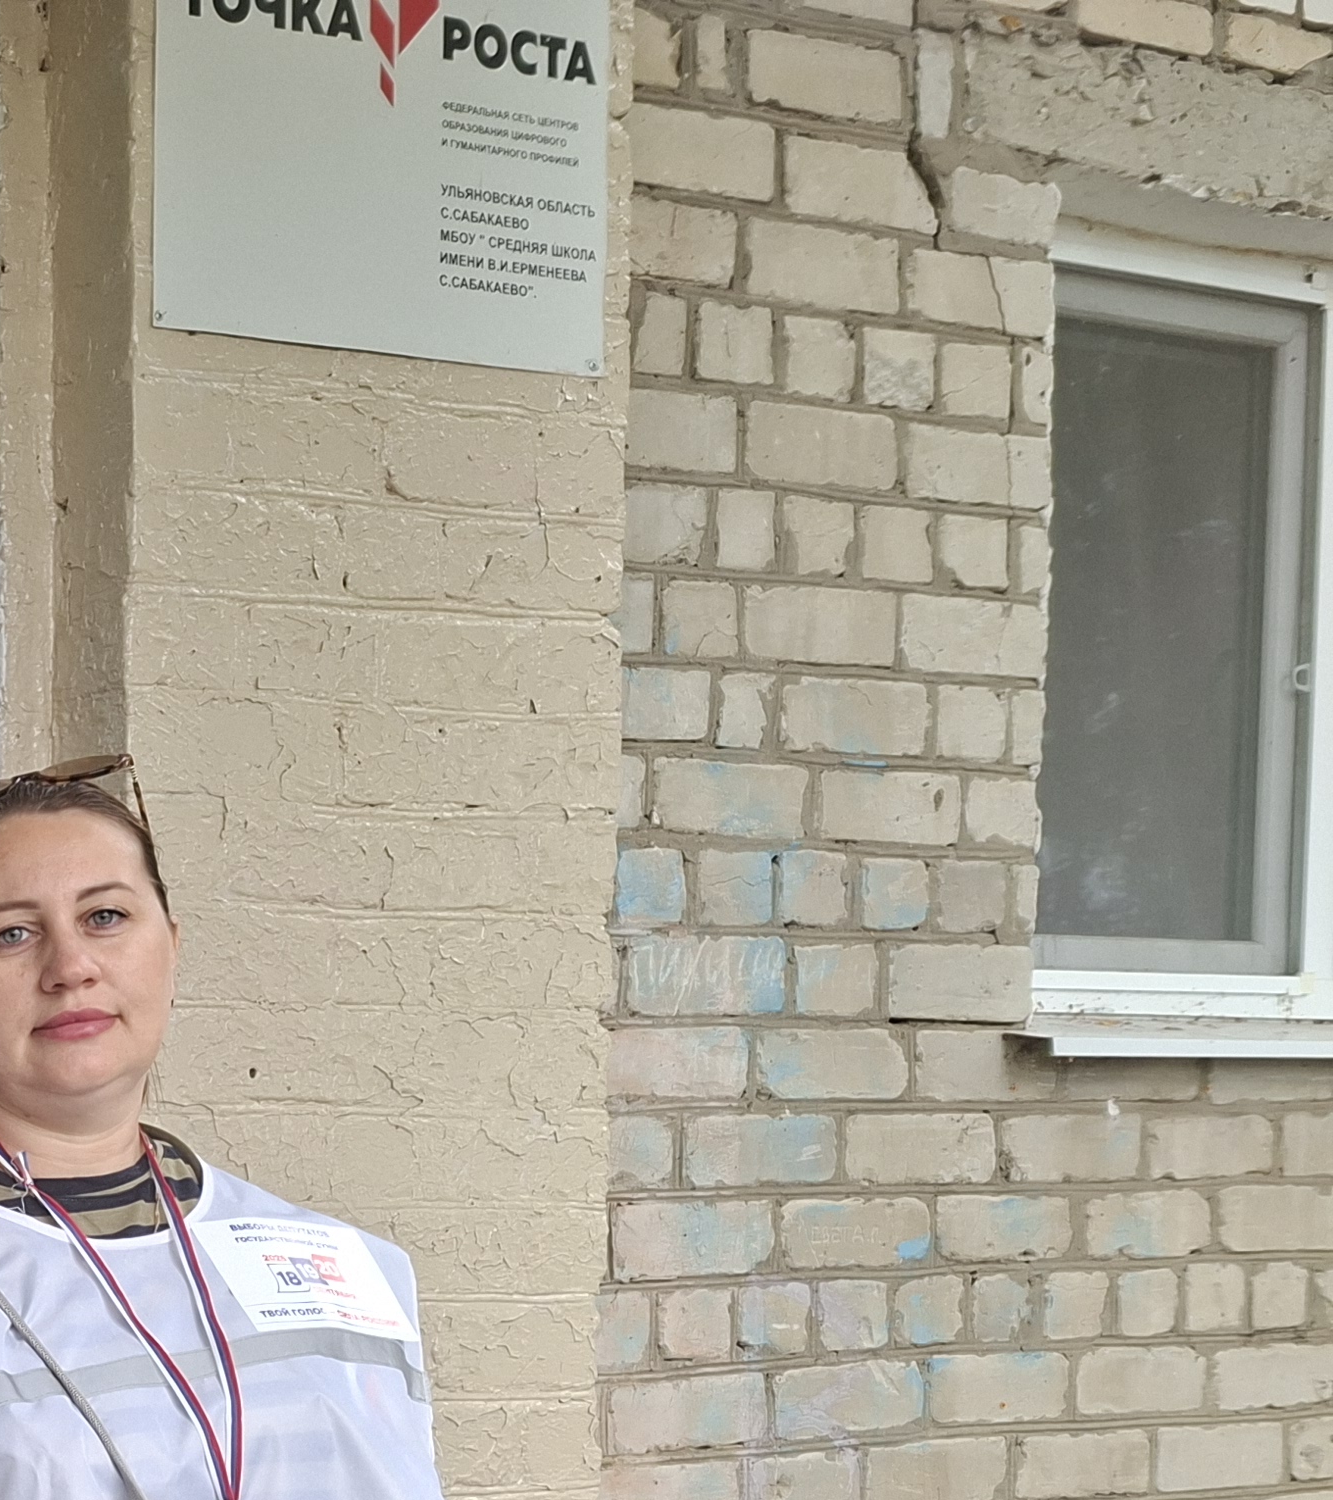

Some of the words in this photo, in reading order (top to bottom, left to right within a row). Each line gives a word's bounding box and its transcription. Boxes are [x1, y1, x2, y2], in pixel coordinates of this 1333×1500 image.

[442, 15, 597, 85] РОСТА
[441, 101, 510, 120] ФЕДЕРАЛЬНАЯ
[512, 113, 536, 125] СЕТЬ
[538, 117, 580, 131] ЦЕНТРОВ
[441, 119, 509, 138] ОБРАЗОВАНИЯ
[511, 131, 567, 148] ЦИФРОВОГО
[441, 138, 448, 147] И
[450, 139, 528, 159] ГУМАНИТАРНОГО
[529, 151, 579, 167] ПРОФИЛЕЙ
[440, 184, 533, 209] УЛЬЯНОВСКАЯ
[537, 199, 595, 218] ОБЛАСТЬ
[440, 207, 530, 230] С.САБАКАЕВО
[440, 229, 476, 245] МБОУ
[489, 236, 547, 255] СРЕДНЯЯ
[552, 244, 596, 262] ШКОЛА
[440, 251, 484, 268] ИМЕНИ
[488, 259, 587, 282] В.И.ЕРМЕНЕЕВА
[229, 1224, 275, 1232] ВЫБОРЫ
[276, 1271, 302, 1286] 18
[296, 1263, 319, 1280] 19
[314, 1259, 340, 1277] 20
[259, 1308, 290, 1318] ТВОЙ
[292, 1307, 326, 1316] ГОЛОС
